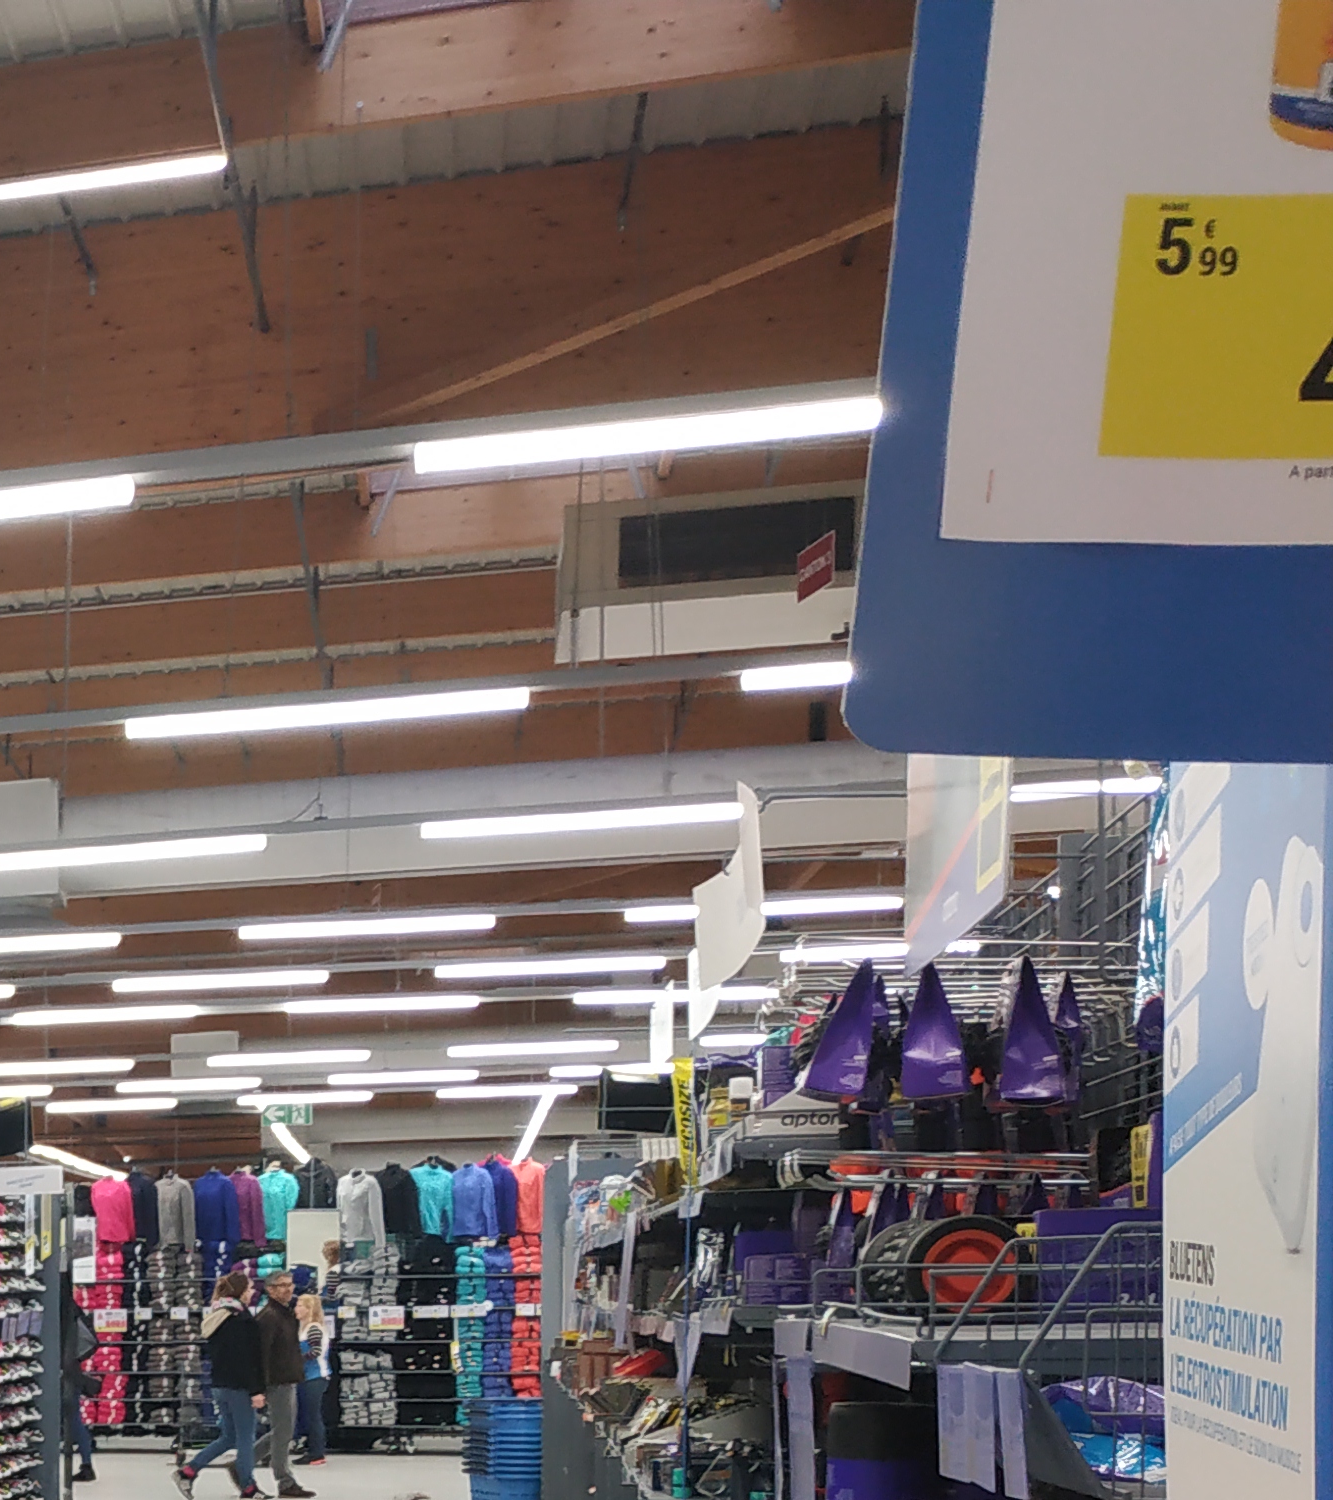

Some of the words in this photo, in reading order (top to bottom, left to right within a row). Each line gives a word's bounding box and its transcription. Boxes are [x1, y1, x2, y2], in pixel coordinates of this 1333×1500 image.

[1169, 1240, 1215, 1287] BLUETENS
[1169, 1296, 1181, 1338] LA
[1182, 1290, 1257, 1358] RÉCUPÉRATION
[1259, 1314, 1282, 1365] PAR
